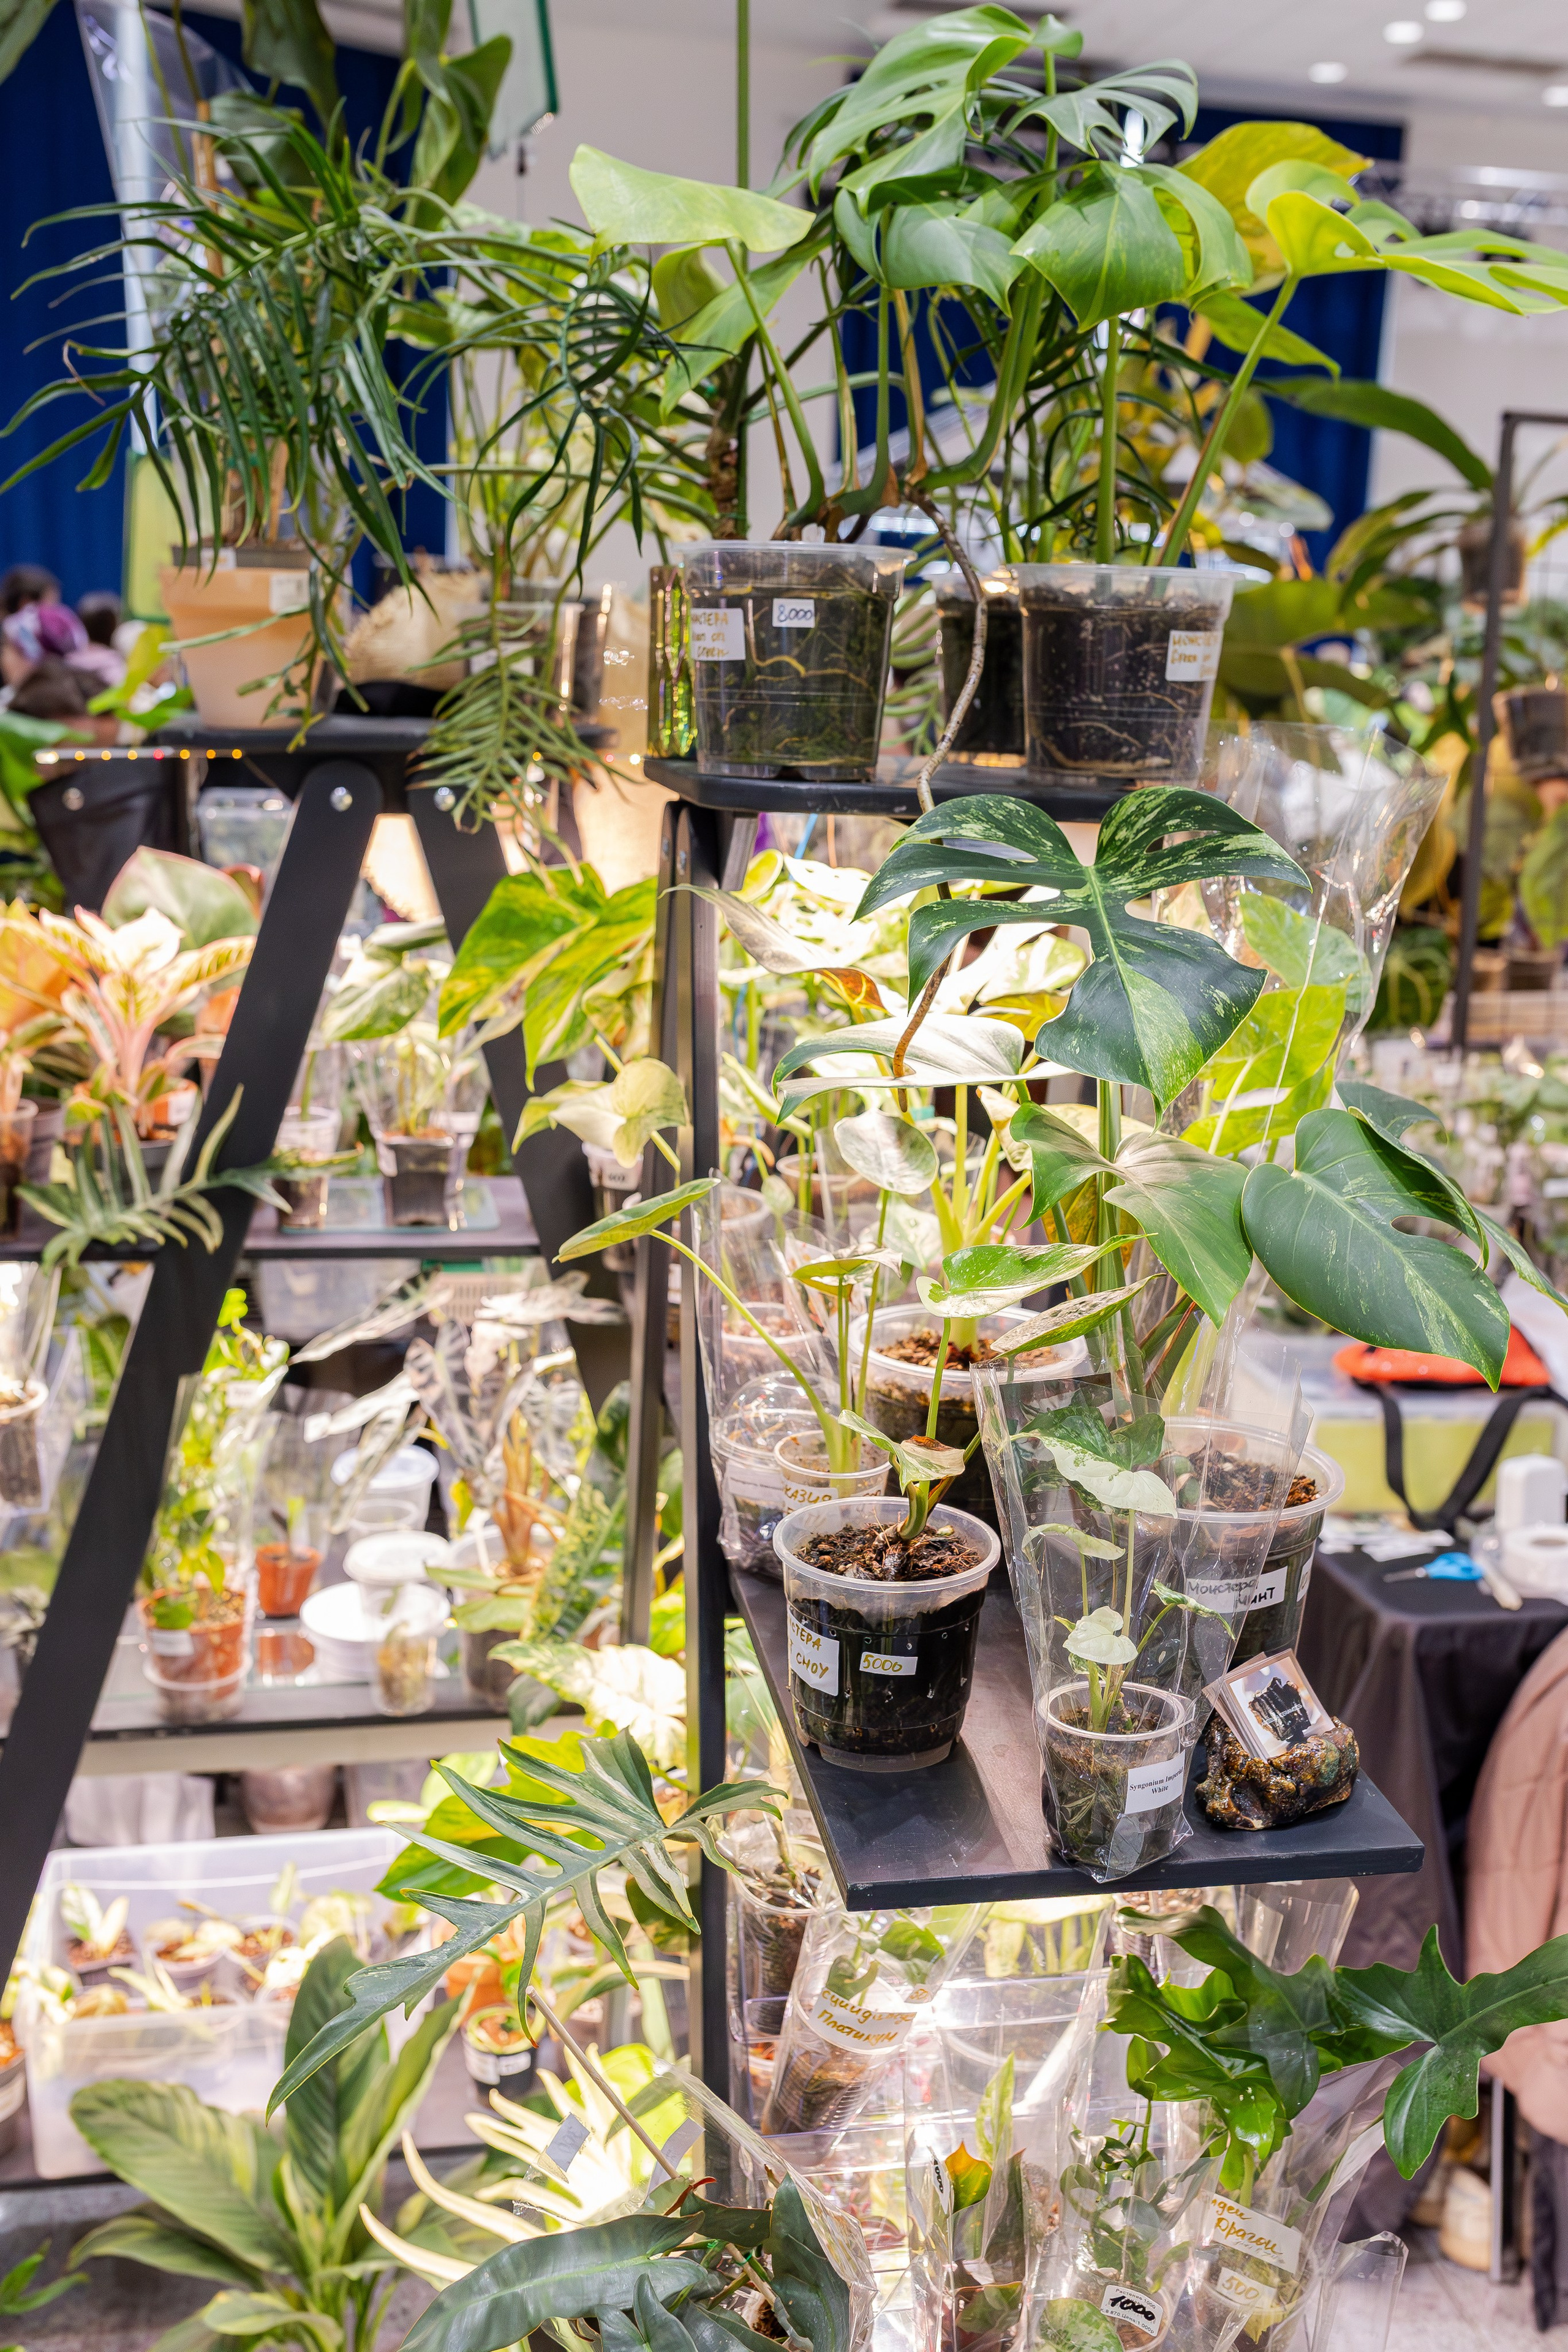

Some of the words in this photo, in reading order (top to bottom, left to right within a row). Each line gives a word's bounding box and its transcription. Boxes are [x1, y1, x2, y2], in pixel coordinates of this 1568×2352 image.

[778, 605, 813, 622] 8000
[791, 1621, 822, 1651] СТЕРА
[862, 1654, 903, 1672] 5000
[1129, 1779, 1164, 1791] Syngonium
[1166, 1766, 1183, 1782] Imperial
[1152, 1785, 1169, 1794] White
[1222, 2275, 1259, 2299] 500
[1109, 2295, 1155, 2321] 1000
